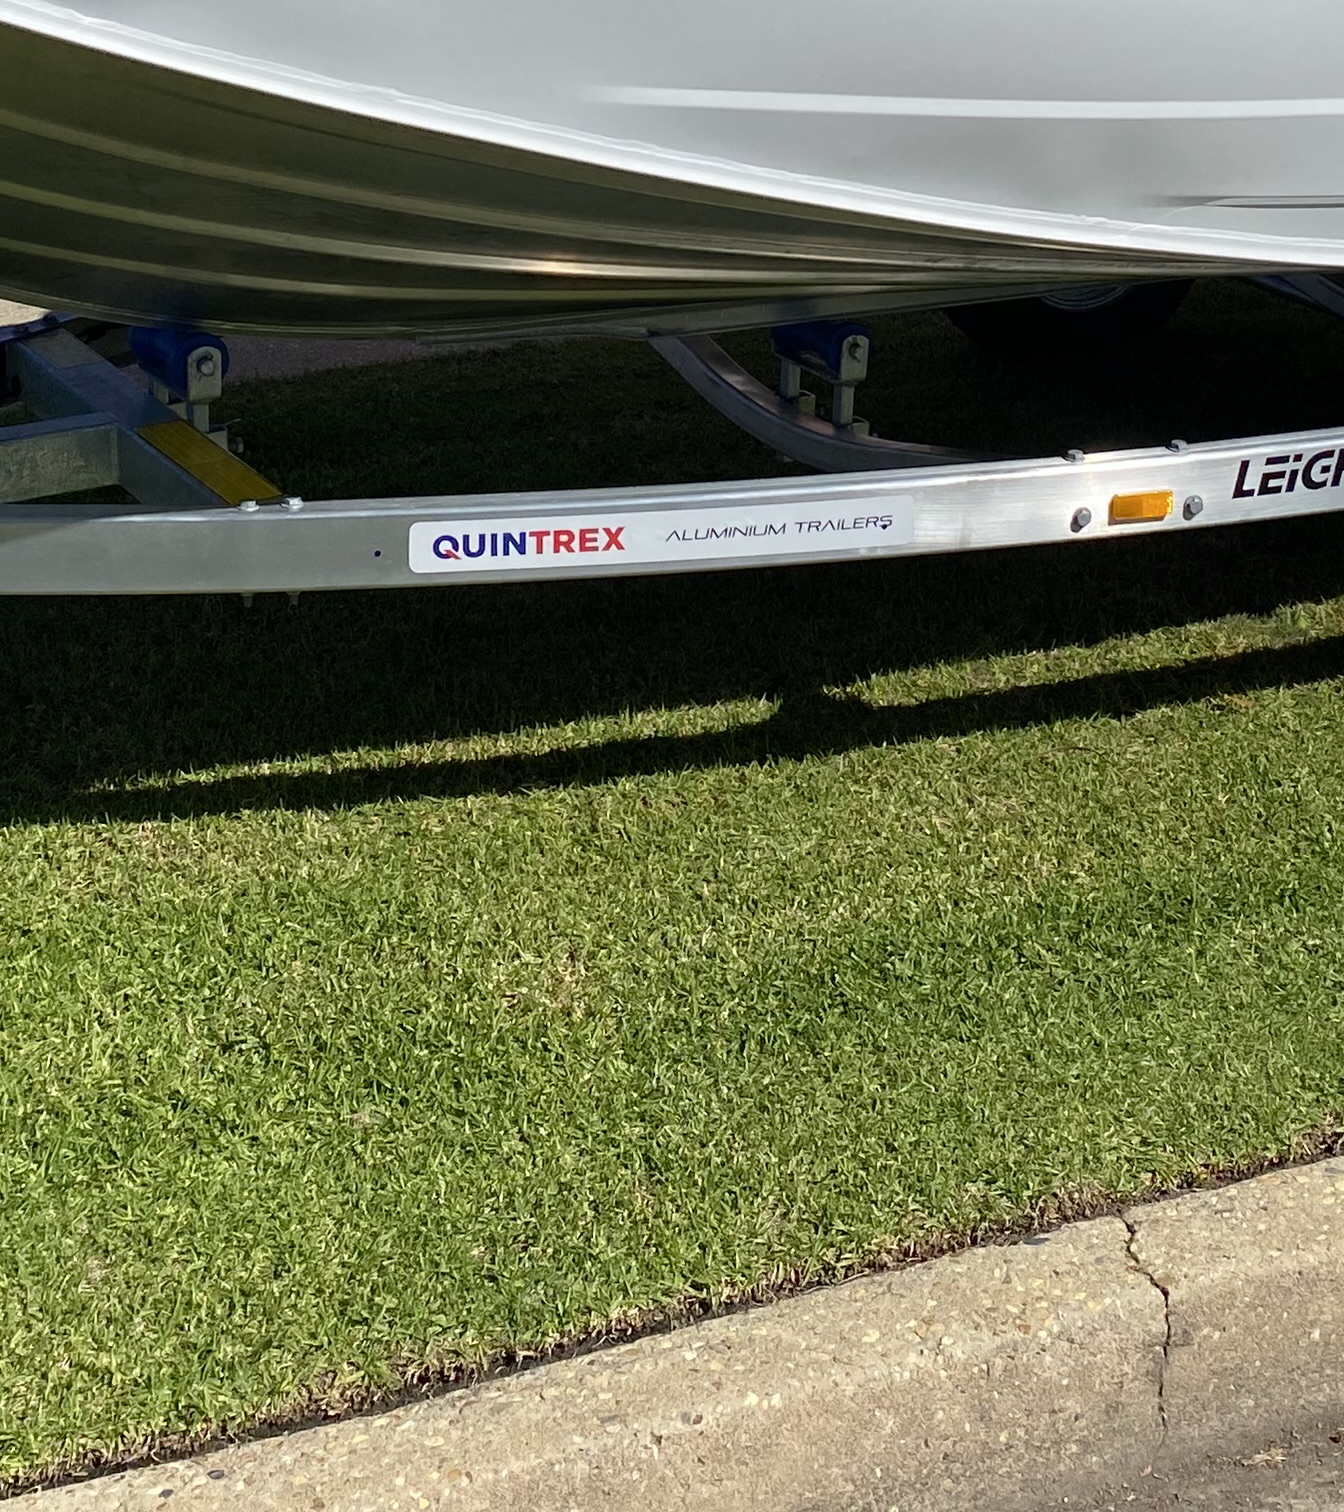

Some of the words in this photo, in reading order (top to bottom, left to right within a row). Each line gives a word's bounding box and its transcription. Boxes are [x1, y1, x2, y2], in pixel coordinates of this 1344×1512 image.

[432, 525, 626, 561] QUINTREX
[665, 521, 787, 543] ALUMINIUM
[794, 514, 894, 535] TRAILERS
